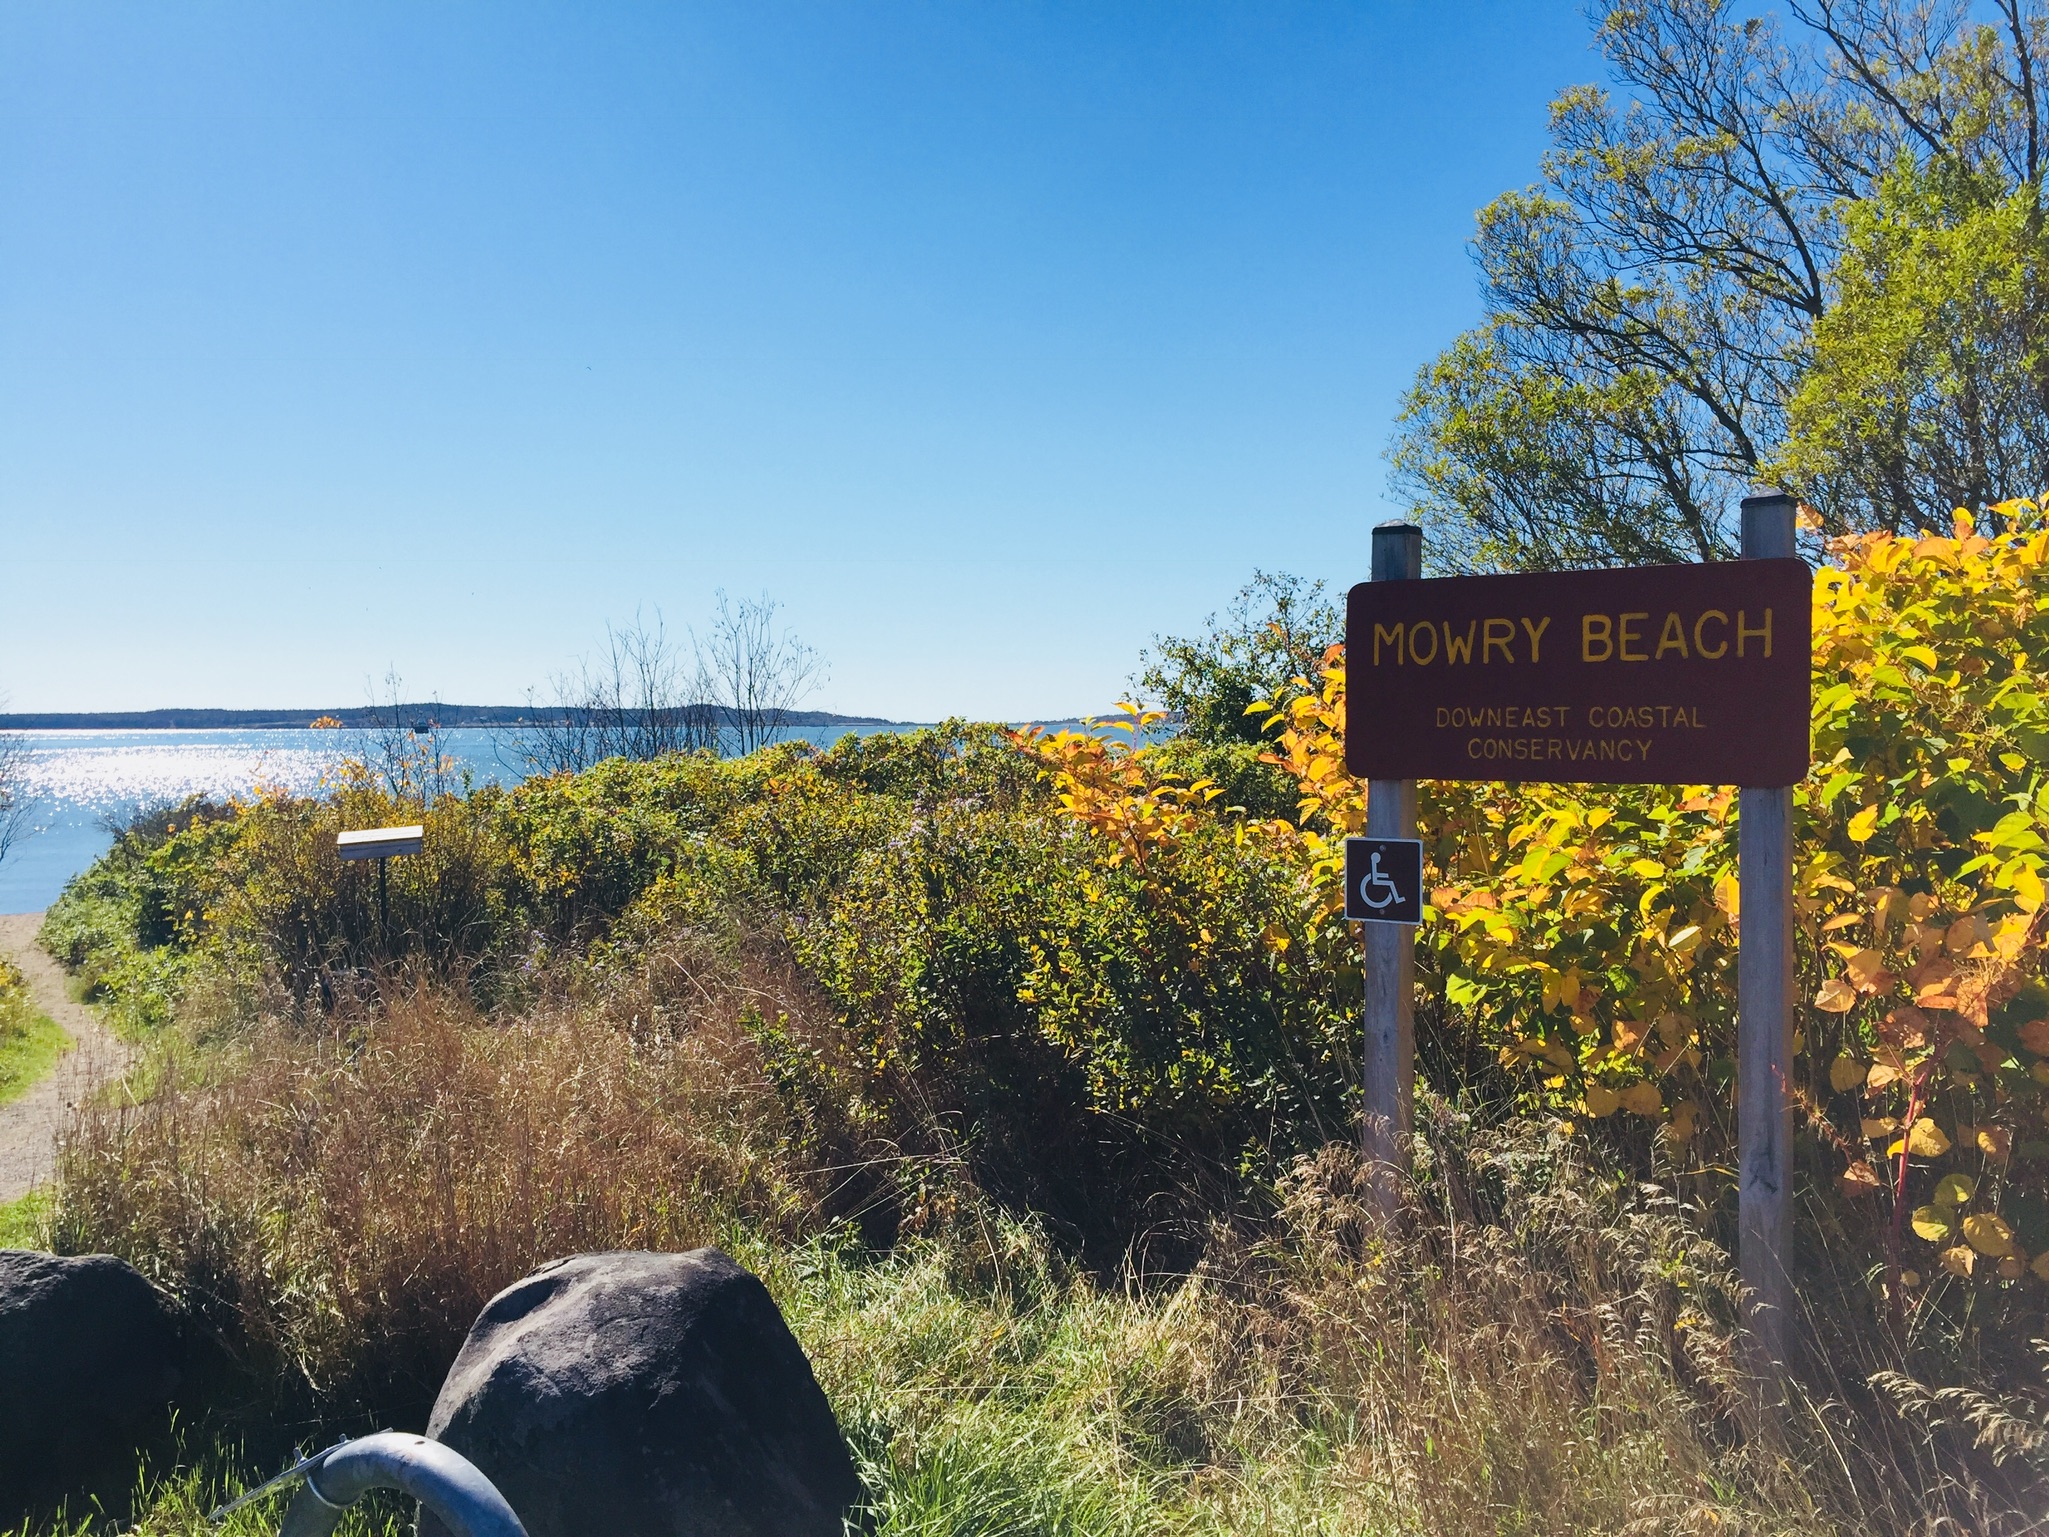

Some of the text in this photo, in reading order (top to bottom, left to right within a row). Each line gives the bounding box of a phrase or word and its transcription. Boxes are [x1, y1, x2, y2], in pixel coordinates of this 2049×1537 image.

[1373, 607, 1773, 667] MOWRY BEACH
[1436, 705, 1706, 729] DOWNEAST COASTAL
[1468, 737, 1653, 762] CONSERVANCY
